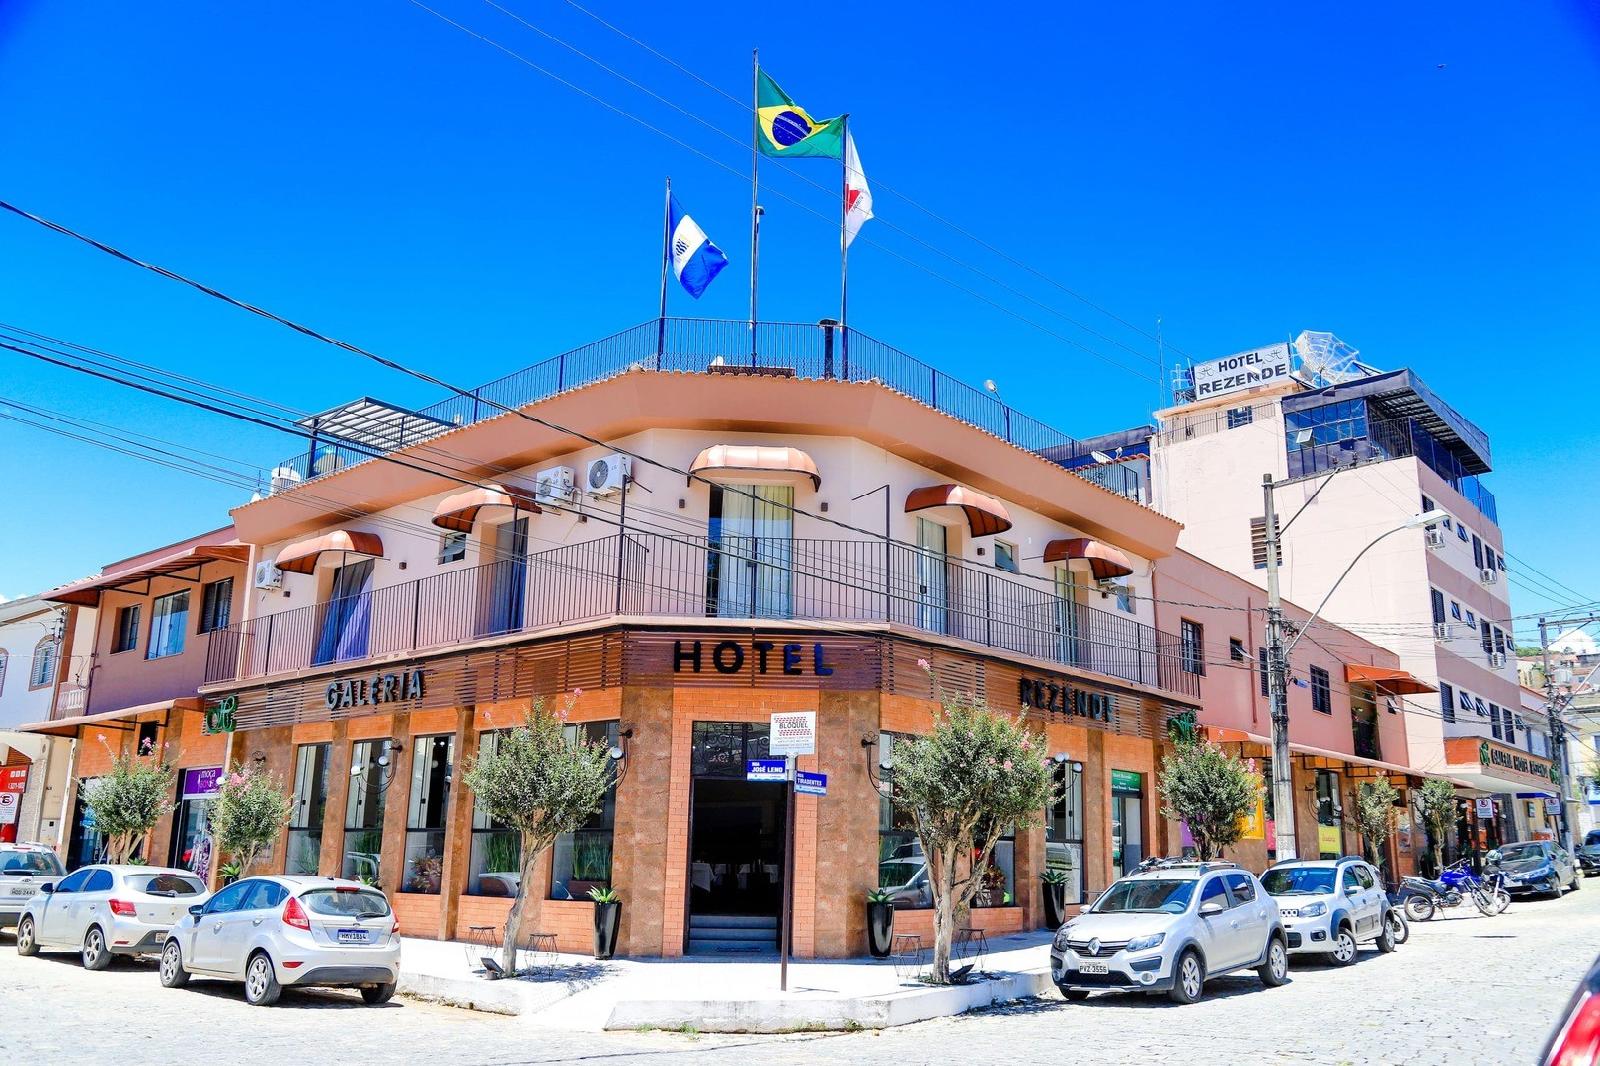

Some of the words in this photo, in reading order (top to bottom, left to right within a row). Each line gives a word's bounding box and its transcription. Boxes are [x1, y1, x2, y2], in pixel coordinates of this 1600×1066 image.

[1198, 363, 1288, 396] REZENDE
[1218, 352, 1263, 373] HOTEL
[673, 640, 833, 676] HOTEL
[325, 669, 425, 711] GALERIA
[1019, 678, 1118, 724] REZENDE
